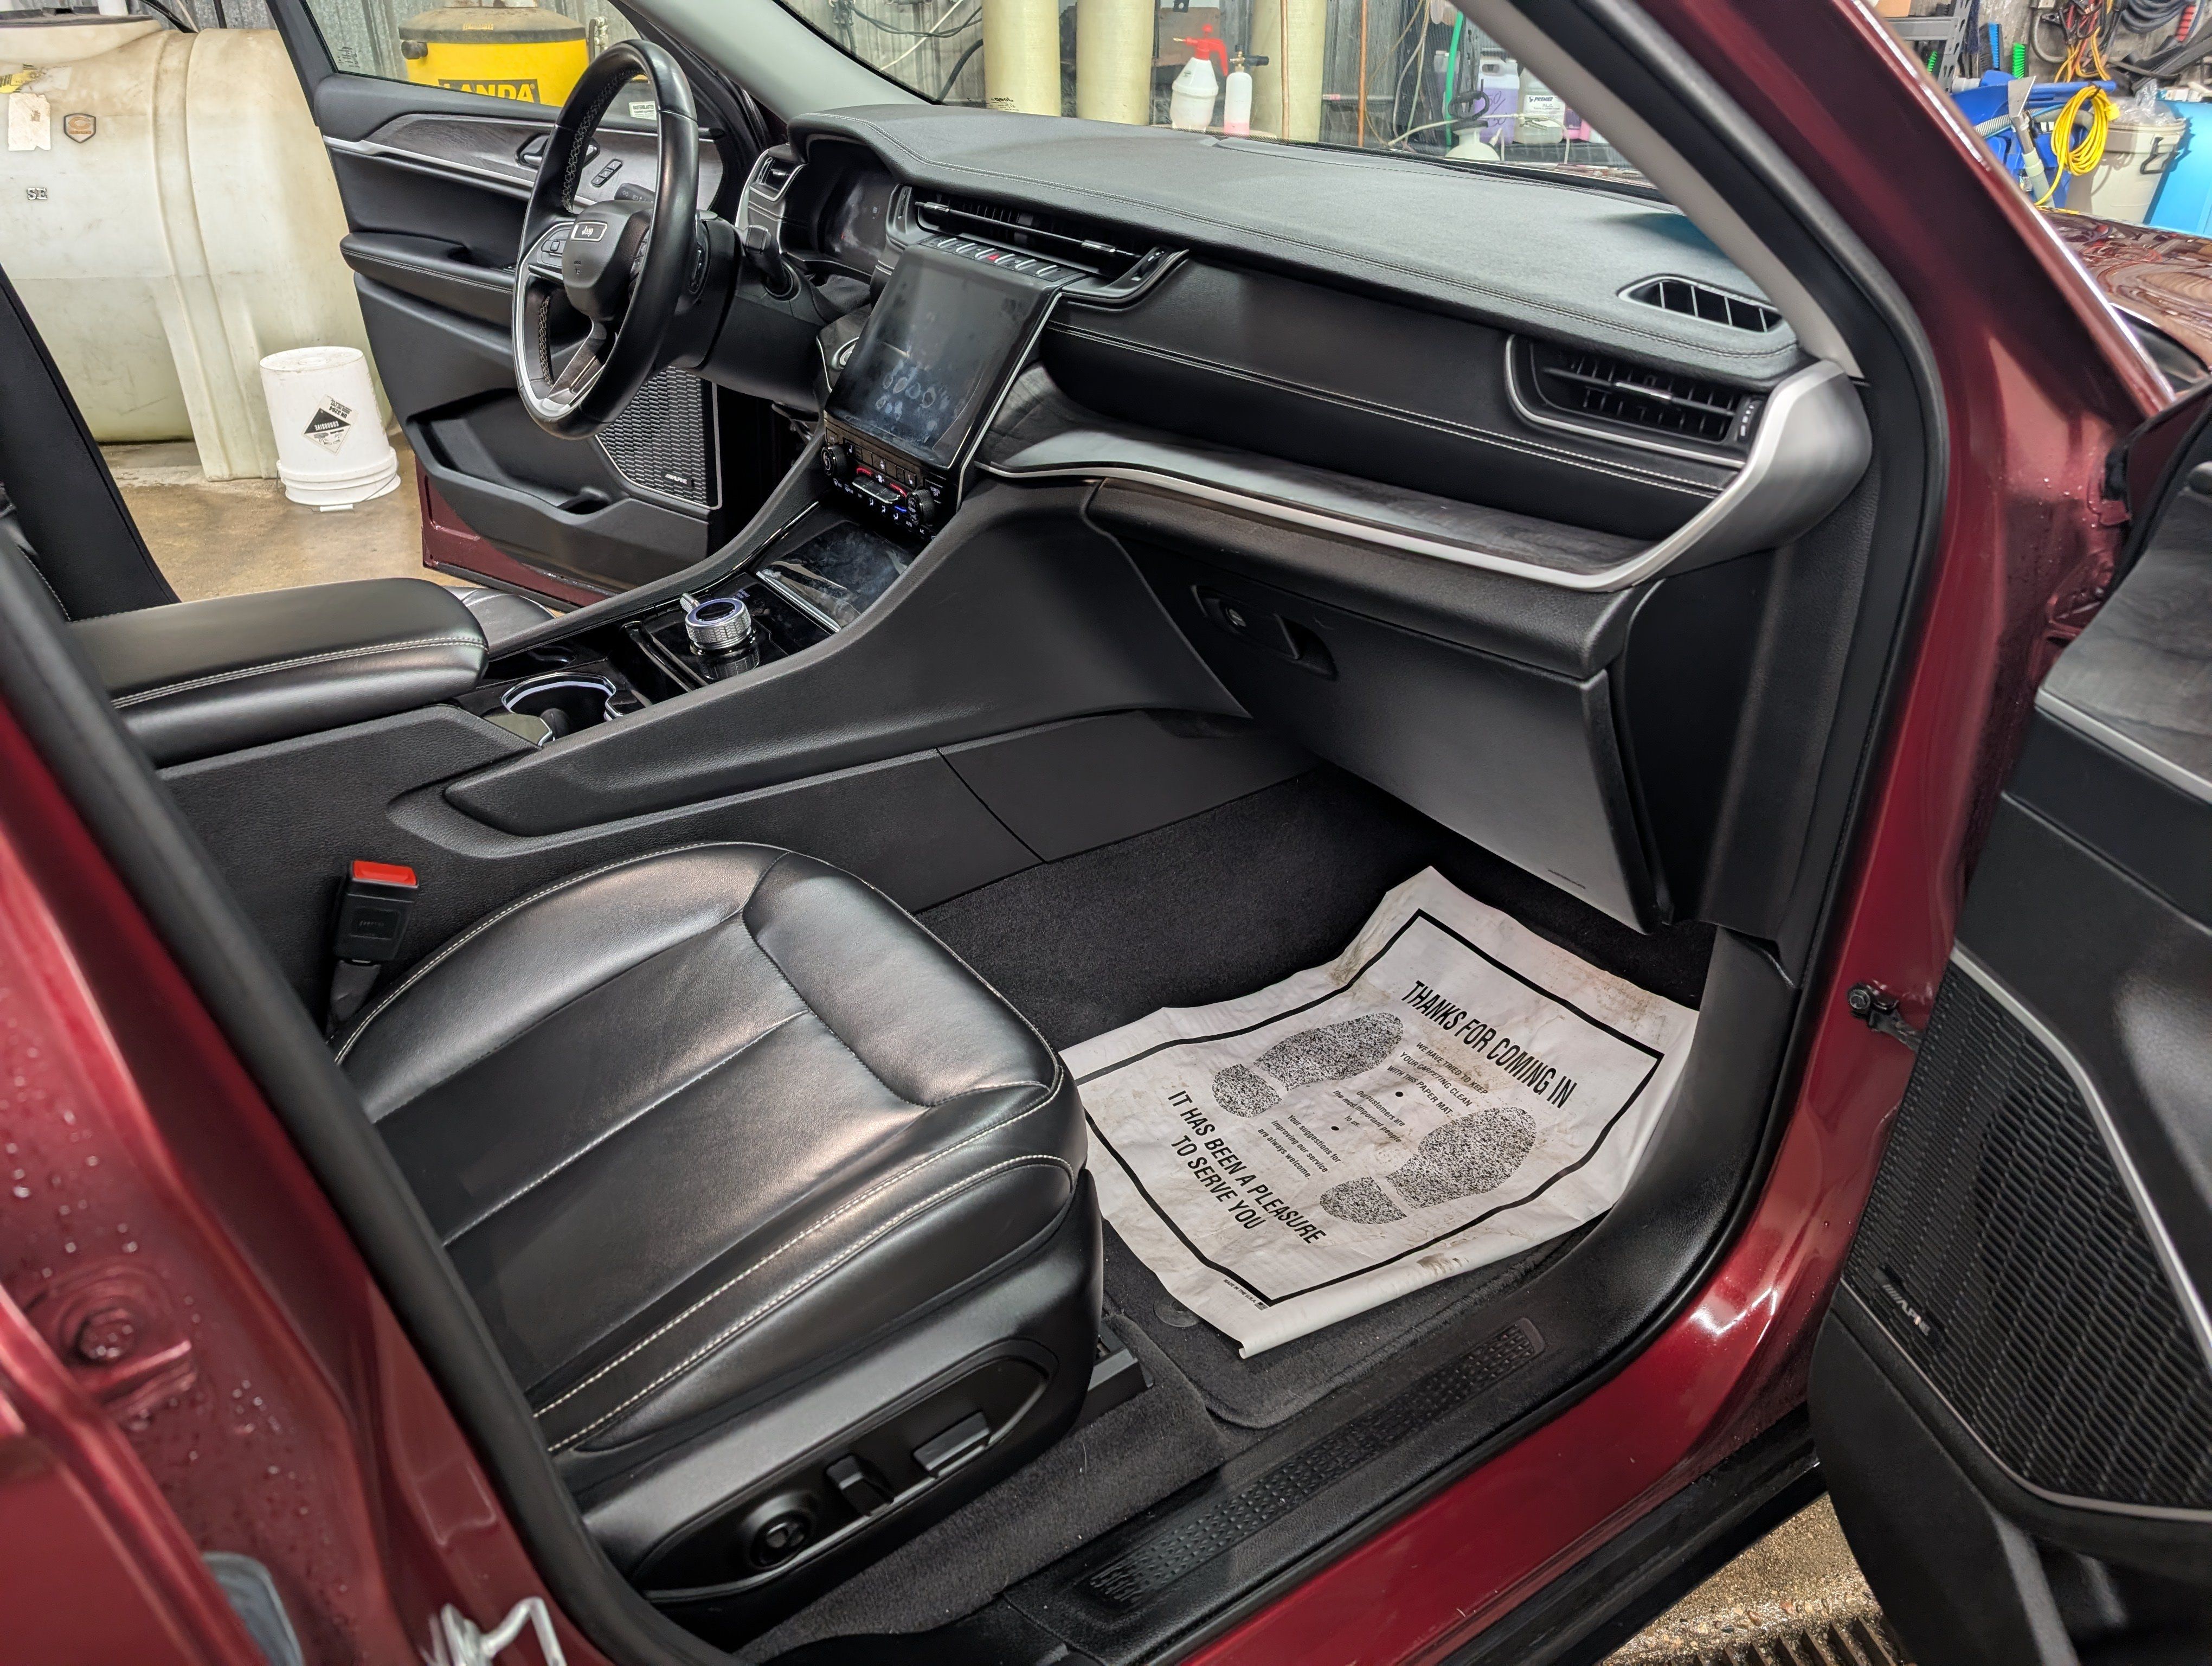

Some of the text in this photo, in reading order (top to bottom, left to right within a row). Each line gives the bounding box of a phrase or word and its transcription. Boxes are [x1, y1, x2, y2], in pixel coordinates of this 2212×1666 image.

[27, 188, 47, 200] SE
[314, 420, 339, 431] CORROSIVE
[1401, 980, 1578, 1109] THANKS FOR COMING IN
[1416, 1042, 1488, 1094] WE HAVE TRIED TO KEEP
[1387, 1065, 1405, 1077] WITH
[1403, 1073, 1419, 1083] THIS
[1416, 1081, 1438, 1103] PAPER
[1400, 1051, 1472, 1107] YOUR CARPETING CLEAN
[1333, 1090, 1402, 1143] the most important people
[1366, 1095, 1396, 1120] customers
[1393, 1118, 1405, 1127] are
[1258, 1128, 1311, 1180] are always welcome.
[1288, 1114, 1341, 1163] Your suggestions for
[1296, 1144, 1309, 1153] our
[1306, 1153, 1328, 1172] service
[1167, 1090, 1327, 1244] IT HAS BEEN A PLEASURE
[1171, 1135, 1266, 1229] TO SERVE YOU
